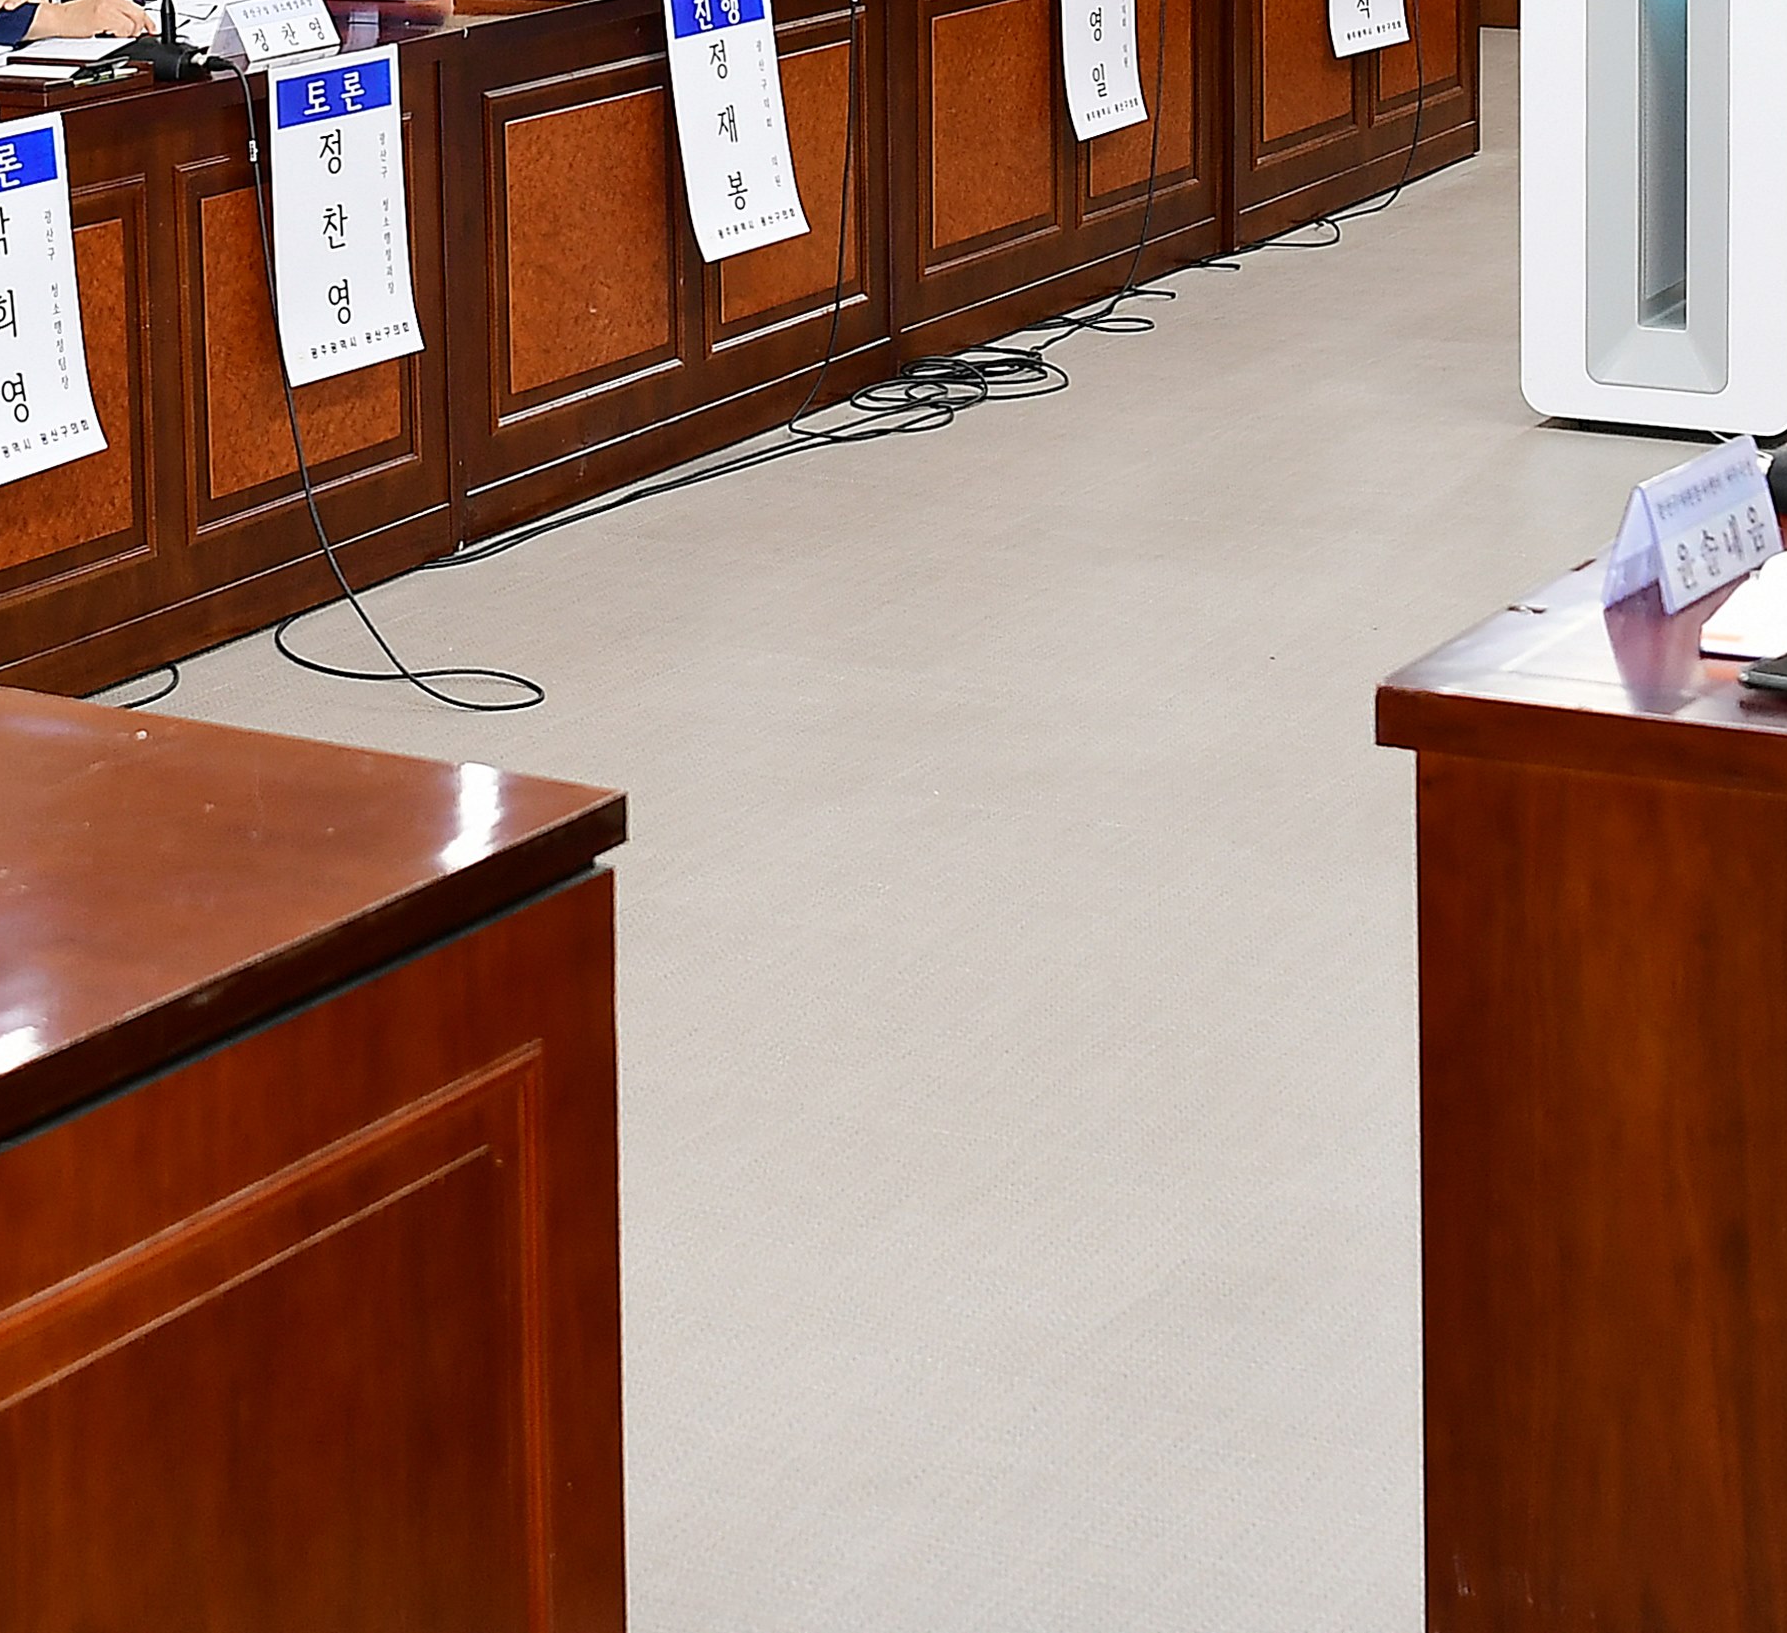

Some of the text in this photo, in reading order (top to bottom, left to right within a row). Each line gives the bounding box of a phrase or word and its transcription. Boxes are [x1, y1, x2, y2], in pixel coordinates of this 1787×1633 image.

[252, 17, 325, 52] 정찬영
[302, 70, 366, 116] 토론
[708, 38, 749, 211] 정재봉
[42, 209, 56, 262] 광산구
[318, 128, 352, 325] 정찬영
[39, 418, 90, 447] 광산구의회
